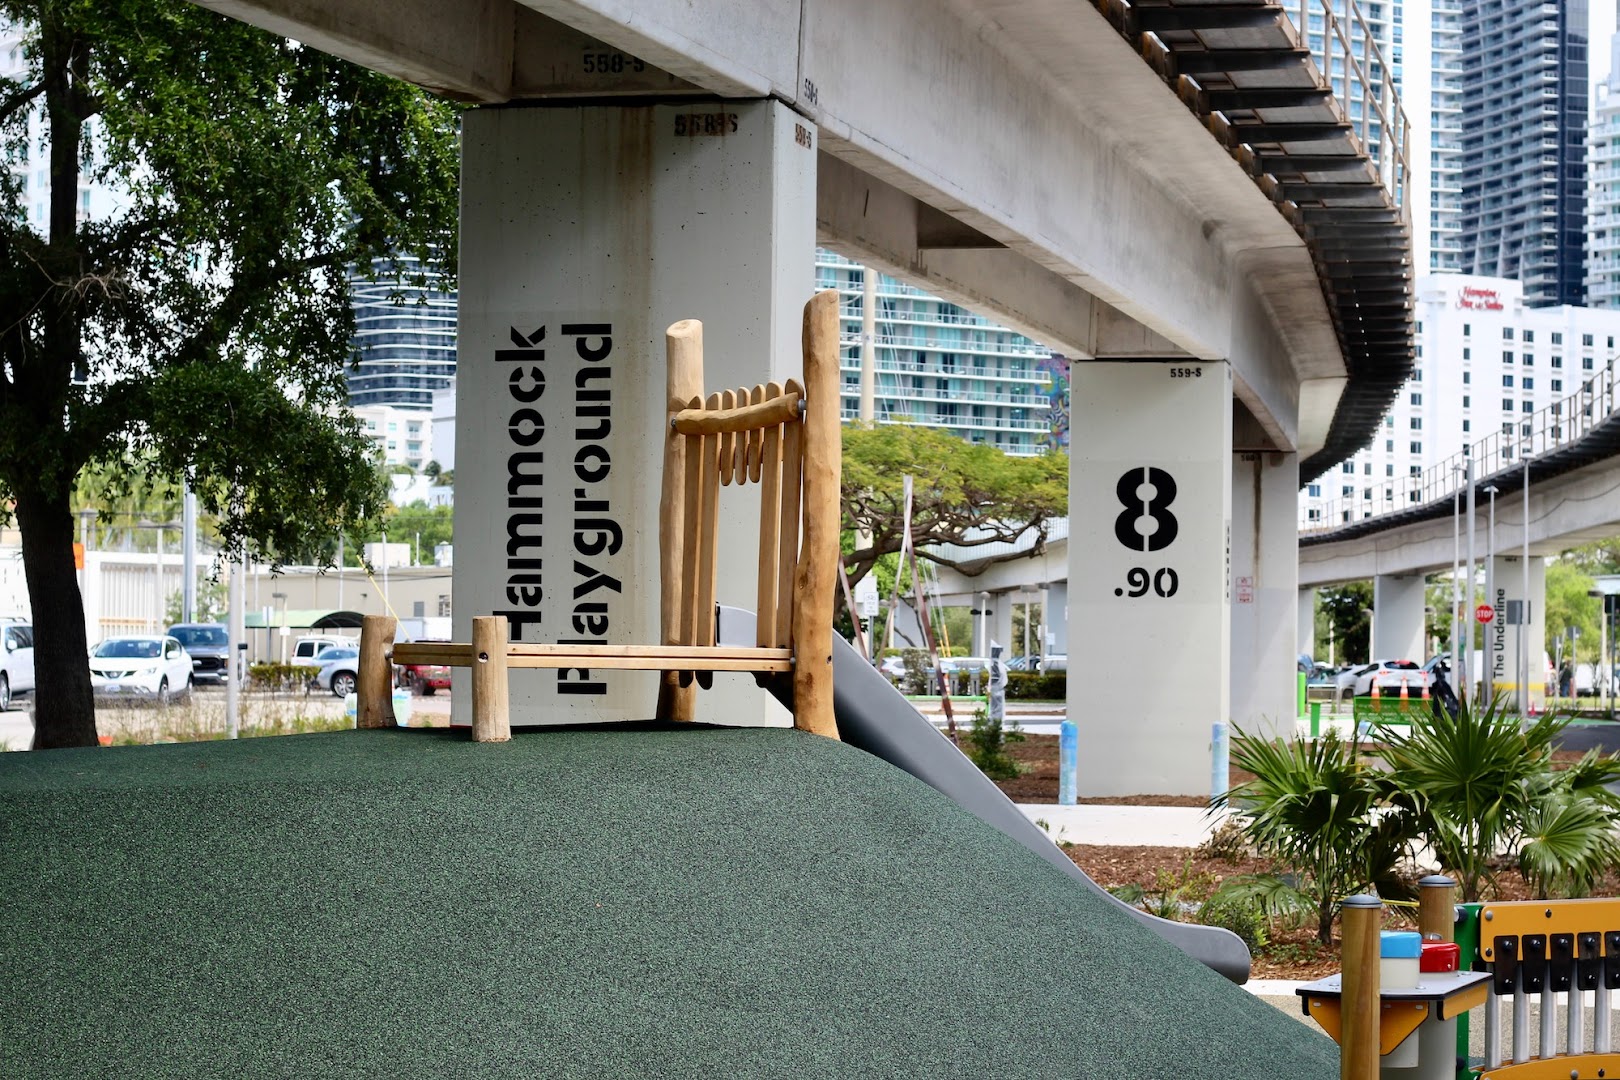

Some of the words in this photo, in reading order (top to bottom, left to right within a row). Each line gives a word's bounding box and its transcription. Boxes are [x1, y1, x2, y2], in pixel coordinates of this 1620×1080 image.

[1170, 368, 1202, 378] 559-S
[1115, 466, 1179, 552] 8
[1114, 567, 1179, 598] .90
[1476, 609, 1493, 618] STOP
[1494, 588, 1505, 651] Underline
[1493, 654, 1505, 679] The
